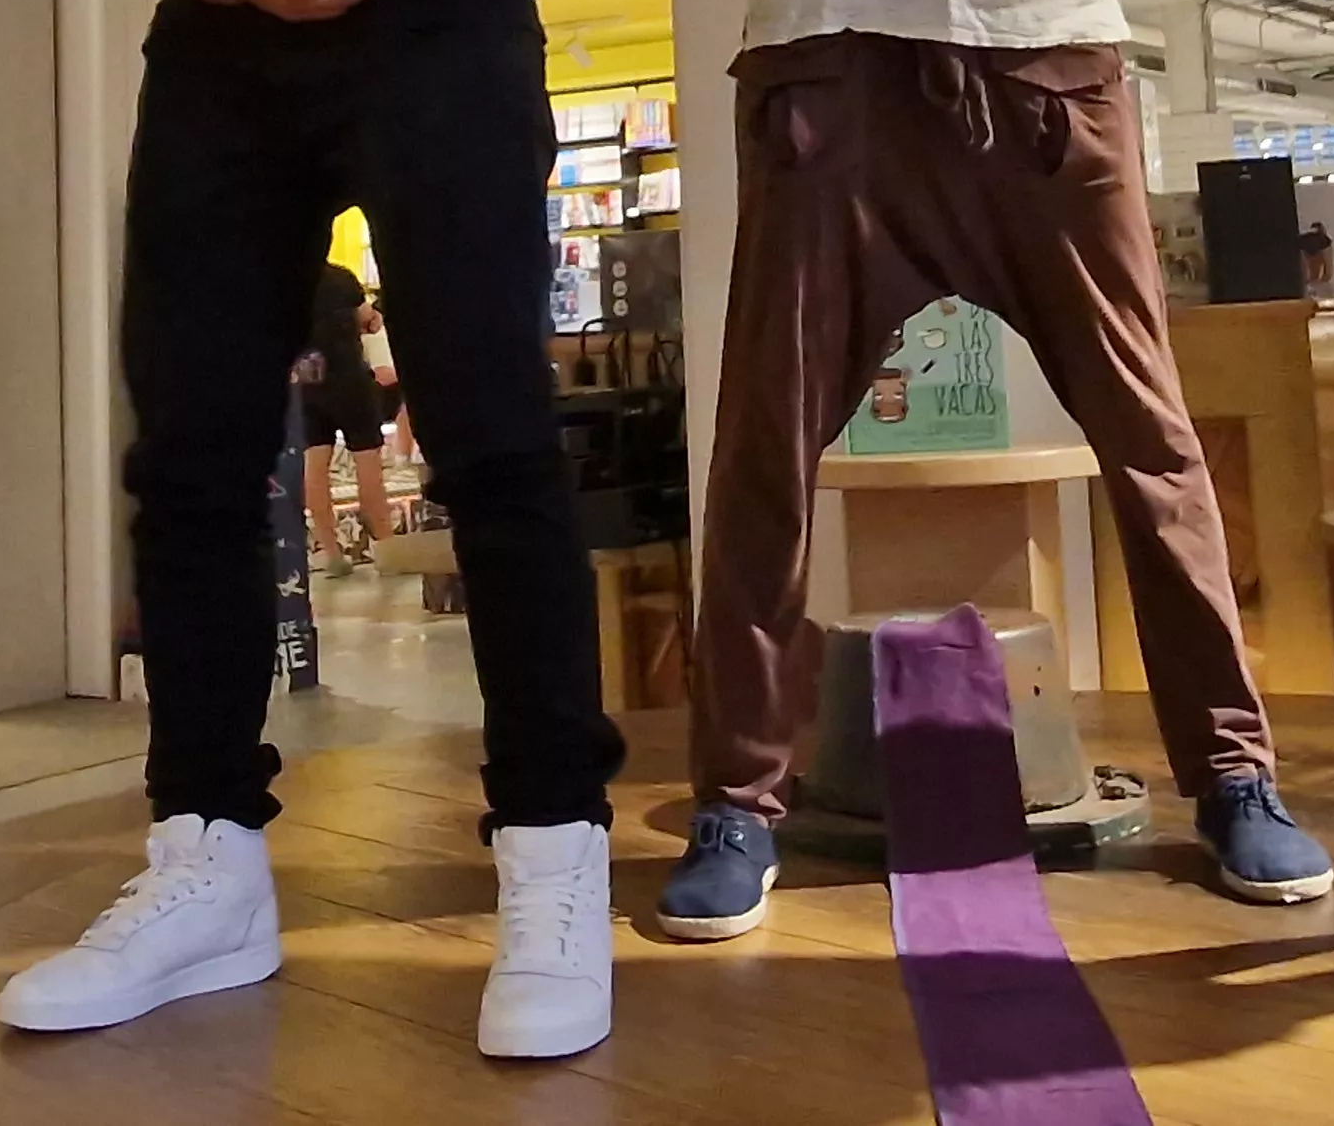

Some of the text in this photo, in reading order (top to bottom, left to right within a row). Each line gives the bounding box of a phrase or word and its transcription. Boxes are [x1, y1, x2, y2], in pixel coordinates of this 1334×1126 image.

[959, 320, 992, 352] LAS
[954, 352, 994, 385] TRES
[934, 384, 997, 417] VACAS
